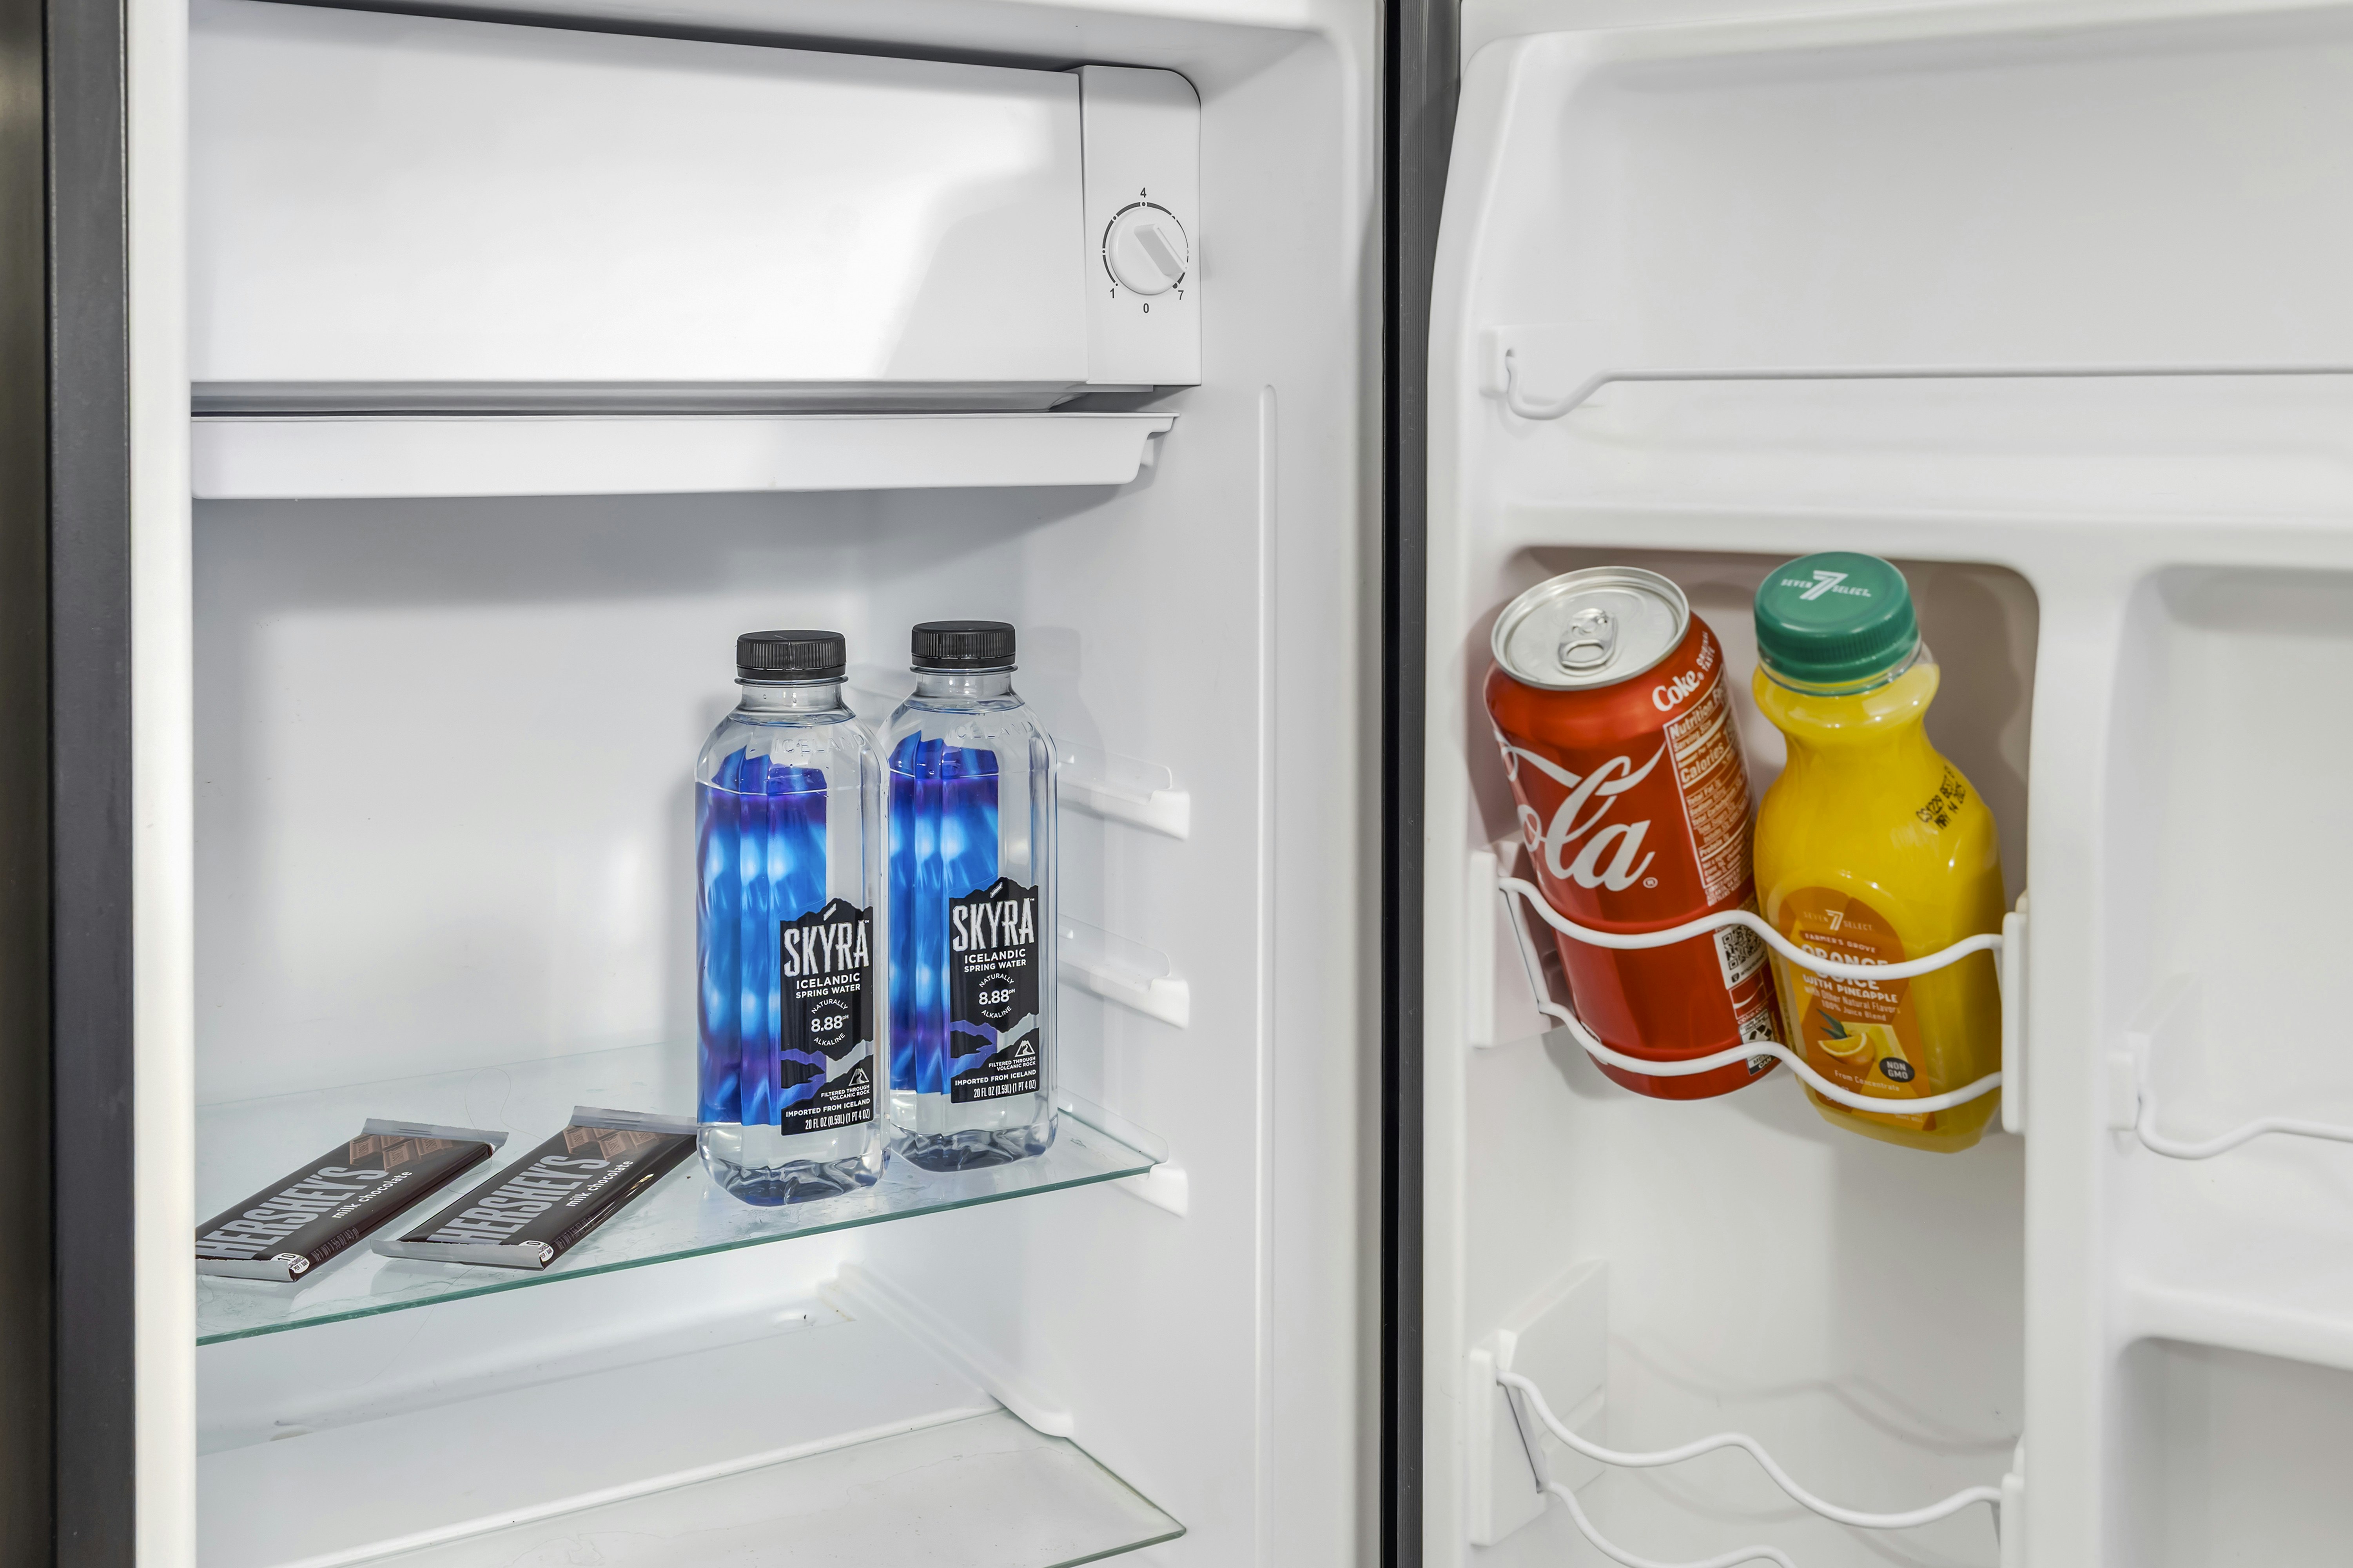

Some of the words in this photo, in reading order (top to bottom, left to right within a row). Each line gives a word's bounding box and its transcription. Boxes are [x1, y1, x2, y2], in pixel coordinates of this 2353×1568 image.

[1140, 187, 1147, 198] 4
[1110, 288, 1114, 298] 1
[1178, 290, 1184, 300] 7
[1143, 303, 1149, 314] 0
[1800, 570, 1849, 600] 7
[1669, 700, 1714, 740] Nutrition
[1680, 743, 1724, 783] Calories
[1825, 909, 1844, 931] 7
[1847, 941, 1876, 953] GROVE
[965, 948, 1026, 964] ICELANDIC
[964, 963, 995, 973] SPRING
[998, 959, 1026, 969] WATER
[796, 973, 860, 990] ICELANDIC
[979, 973, 1014, 988] NATURALLY
[796, 988, 828, 999] SPRING
[831, 984, 861, 994] WATER
[1803, 974, 1833, 990] WITH
[1837, 984, 1898, 1003] PINEAPPLE
[811, 999, 848, 1014] NATURALLY
[1842, 996, 1870, 1010] Natural
[981, 1006, 1012, 1019] ALKALINE
[1843, 1006, 1862, 1017] Juice
[1865, 1011, 1886, 1021] Blend
[813, 1032, 845, 1046] ALKALINE
[1758, 1057, 1772, 1069] CAN
[1887, 1060, 1907, 1070] NON
[955, 1077, 989, 1086] IMPORTED
[1011, 1070, 1036, 1078] ICELAND
[1834, 1070, 1853, 1081] From
[1854, 1076, 1900, 1091] Concentrate
[1888, 1069, 1908, 1079] GMO
[821, 1089, 845, 1098] FILTERED
[846, 1084, 870, 1093] THROUGH
[829, 1093, 855, 1101] VOLCANIC
[974, 1088, 980, 1098] 20
[981, 1088, 987, 1097] FL
[988, 1086, 994, 1096] OZ
[996, 1084, 1012, 1096] (0.59L)
[1018, 1082, 1024, 1091] PT
[1025, 1081, 1028, 1090] 4
[786, 1108, 821, 1117] IMPORTED
[823, 1103, 842, 1112] FROM
[844, 1098, 870, 1109] ICELAND
[805, 1119, 812, 1130] 20
[813, 1118, 819, 1128] FL
[820, 1117, 827, 1127] OZ
[828, 1114, 845, 1127] (0.59L)
[852, 1112, 858, 1122] PT
[858, 1111, 862, 1120] 4
[566, 1191, 592, 1207] milk
[588, 1160, 633, 1191] chocolate
[332, 1203, 361, 1219] milk
[359, 1171, 412, 1202] chocolate
[426, 1155, 610, 1245] HERSHEY'S
[195, 1167, 390, 1260] HERSHEY'S
[311, 1249, 323, 1262] NET
